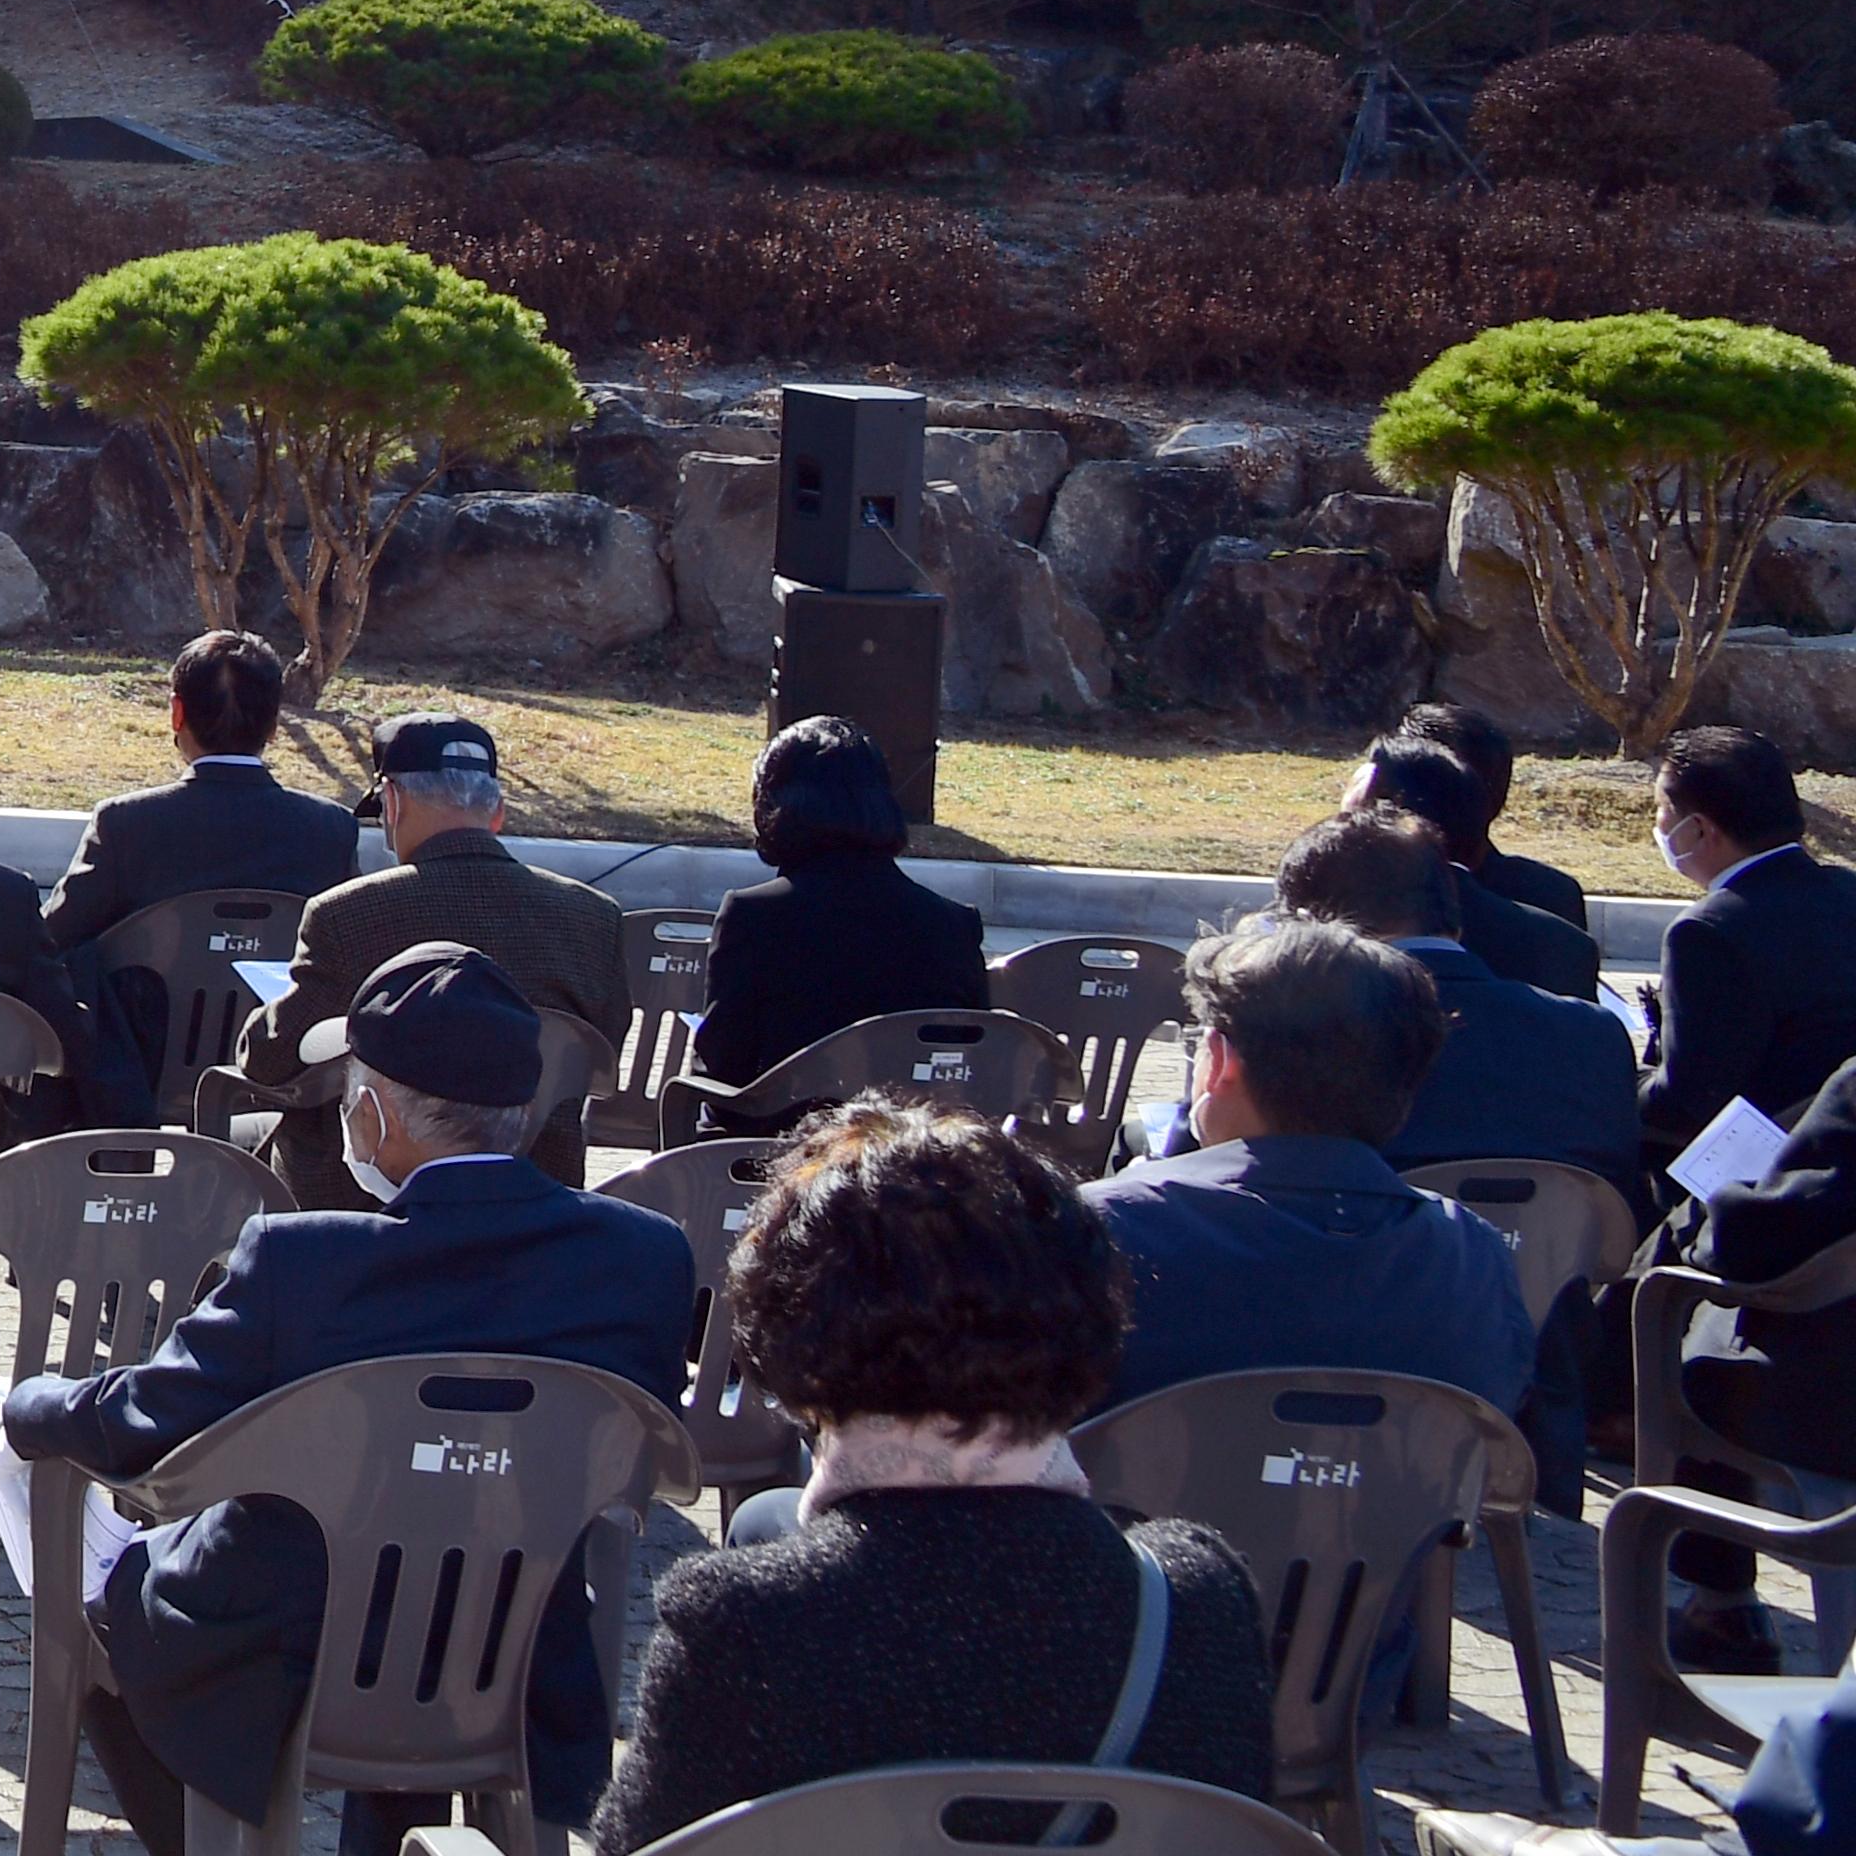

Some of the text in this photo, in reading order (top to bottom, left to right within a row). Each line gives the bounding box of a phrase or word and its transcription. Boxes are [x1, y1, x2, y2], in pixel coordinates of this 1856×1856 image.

[228, 937, 261, 953] 나라
[668, 959, 701, 975] 나라
[934, 1065, 972, 1082] 나라
[111, 1201, 158, 1224] 나라
[449, 1448, 512, 1475] 나라
[1299, 1461, 1361, 1487] 나라
